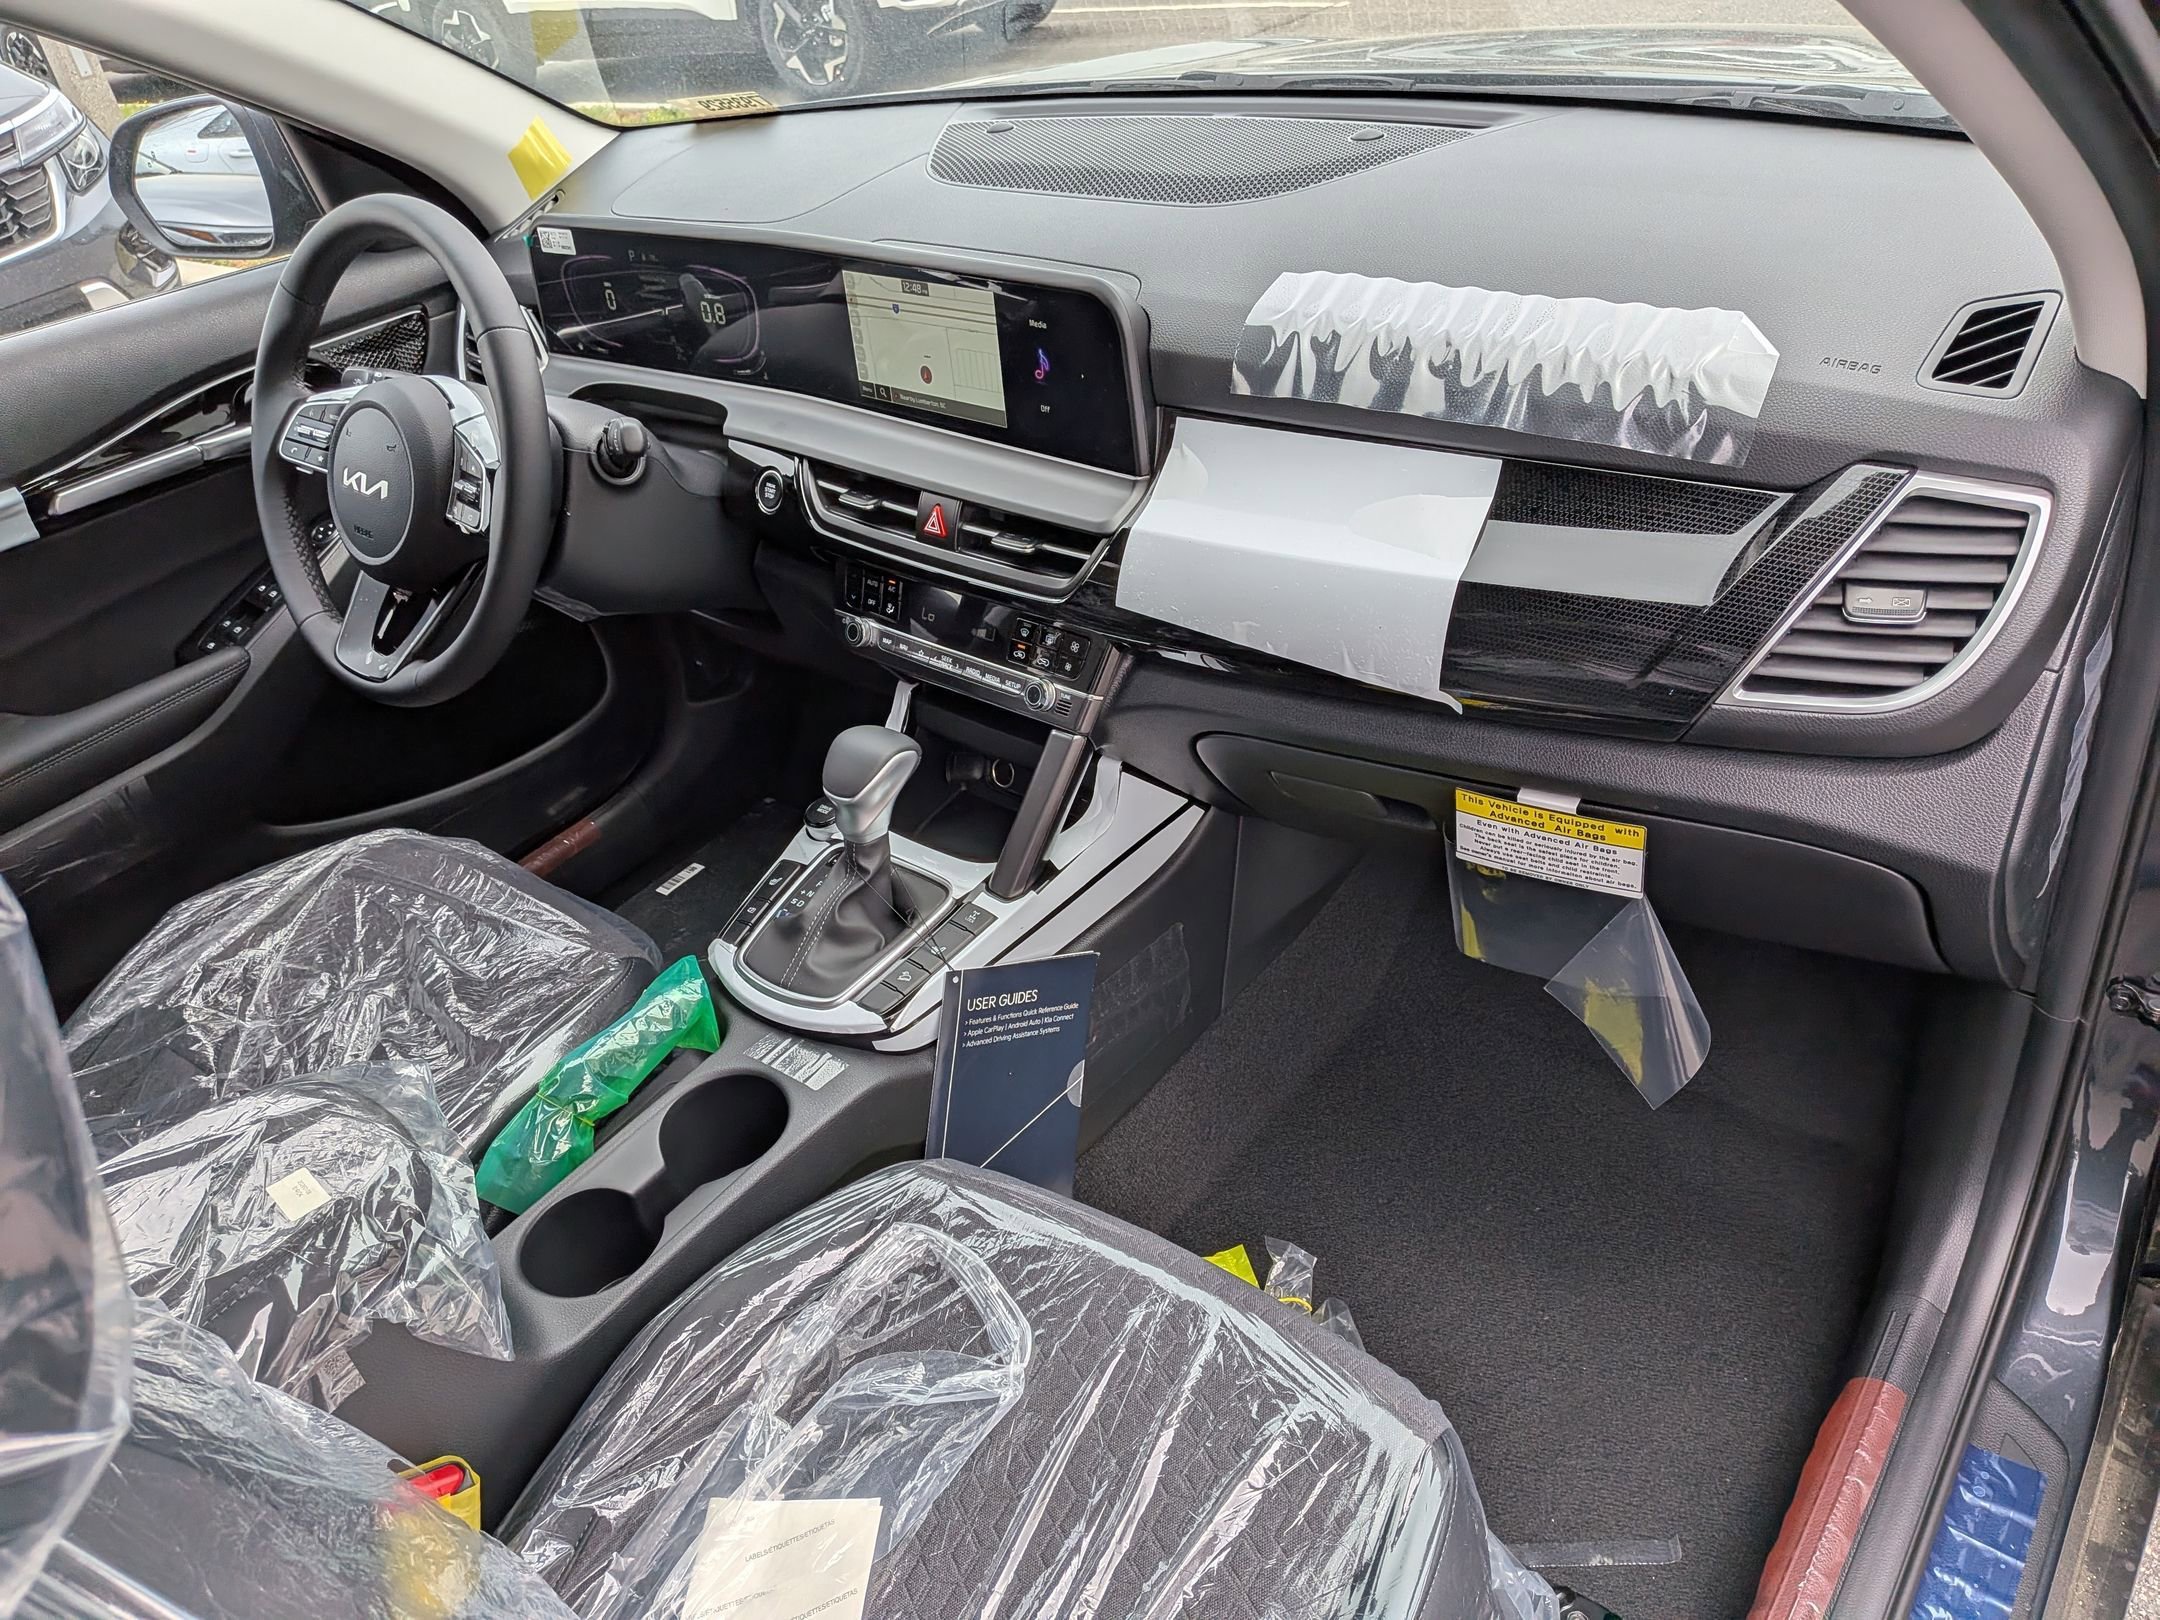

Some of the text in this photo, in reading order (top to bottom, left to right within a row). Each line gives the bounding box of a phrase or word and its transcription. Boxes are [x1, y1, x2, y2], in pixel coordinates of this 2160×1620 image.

[700, 301, 726, 325] 0.8
[1029, 319, 1047, 329] Media
[1819, 357, 1882, 374] AIRBAG
[1040, 404, 1050, 413] Off
[965, 666, 980, 676] RADIO
[985, 672, 1001, 683] MEDIA
[1005, 680, 1021, 689] SETUP
[1462, 794, 1640, 837] This Vehicle is Equipped with
[1490, 811, 1606, 841] Advanced Air Bags
[1460, 824, 1483, 833] Children
[1508, 836, 1524, 844] killed
[1535, 842, 1563, 852] seriously
[1564, 848, 1588, 857] injured
[1474, 839, 1491, 847] Never
[1476, 820, 1498, 830] Even
[1502, 827, 1520, 835] with
[1524, 831, 1570, 846] Advanced
[1593, 846, 1618, 855] Bags
[1528, 863, 1544, 871] more
[806, 890, 815, 898] N
[968, 989, 1039, 1011] USER GUIDES
[968, 1016, 992, 1026] Features
[998, 1012, 1023, 1021] Functions
[1023, 1008, 1038, 1017] Quick
[1038, 1005, 1064, 1014] Reference
[1064, 1002, 1079, 1010] Guide
[967, 1028, 984, 1037] Apple
[984, 1025, 1005, 1034] CarPlay
[1008, 1020, 1029, 1030] Android
[1029, 1018, 1041, 1026] Auto
[1053, 1014, 1075, 1022] Connect
[966, 1026, 1061, 1048] Advanced Driving Assistance Systems
